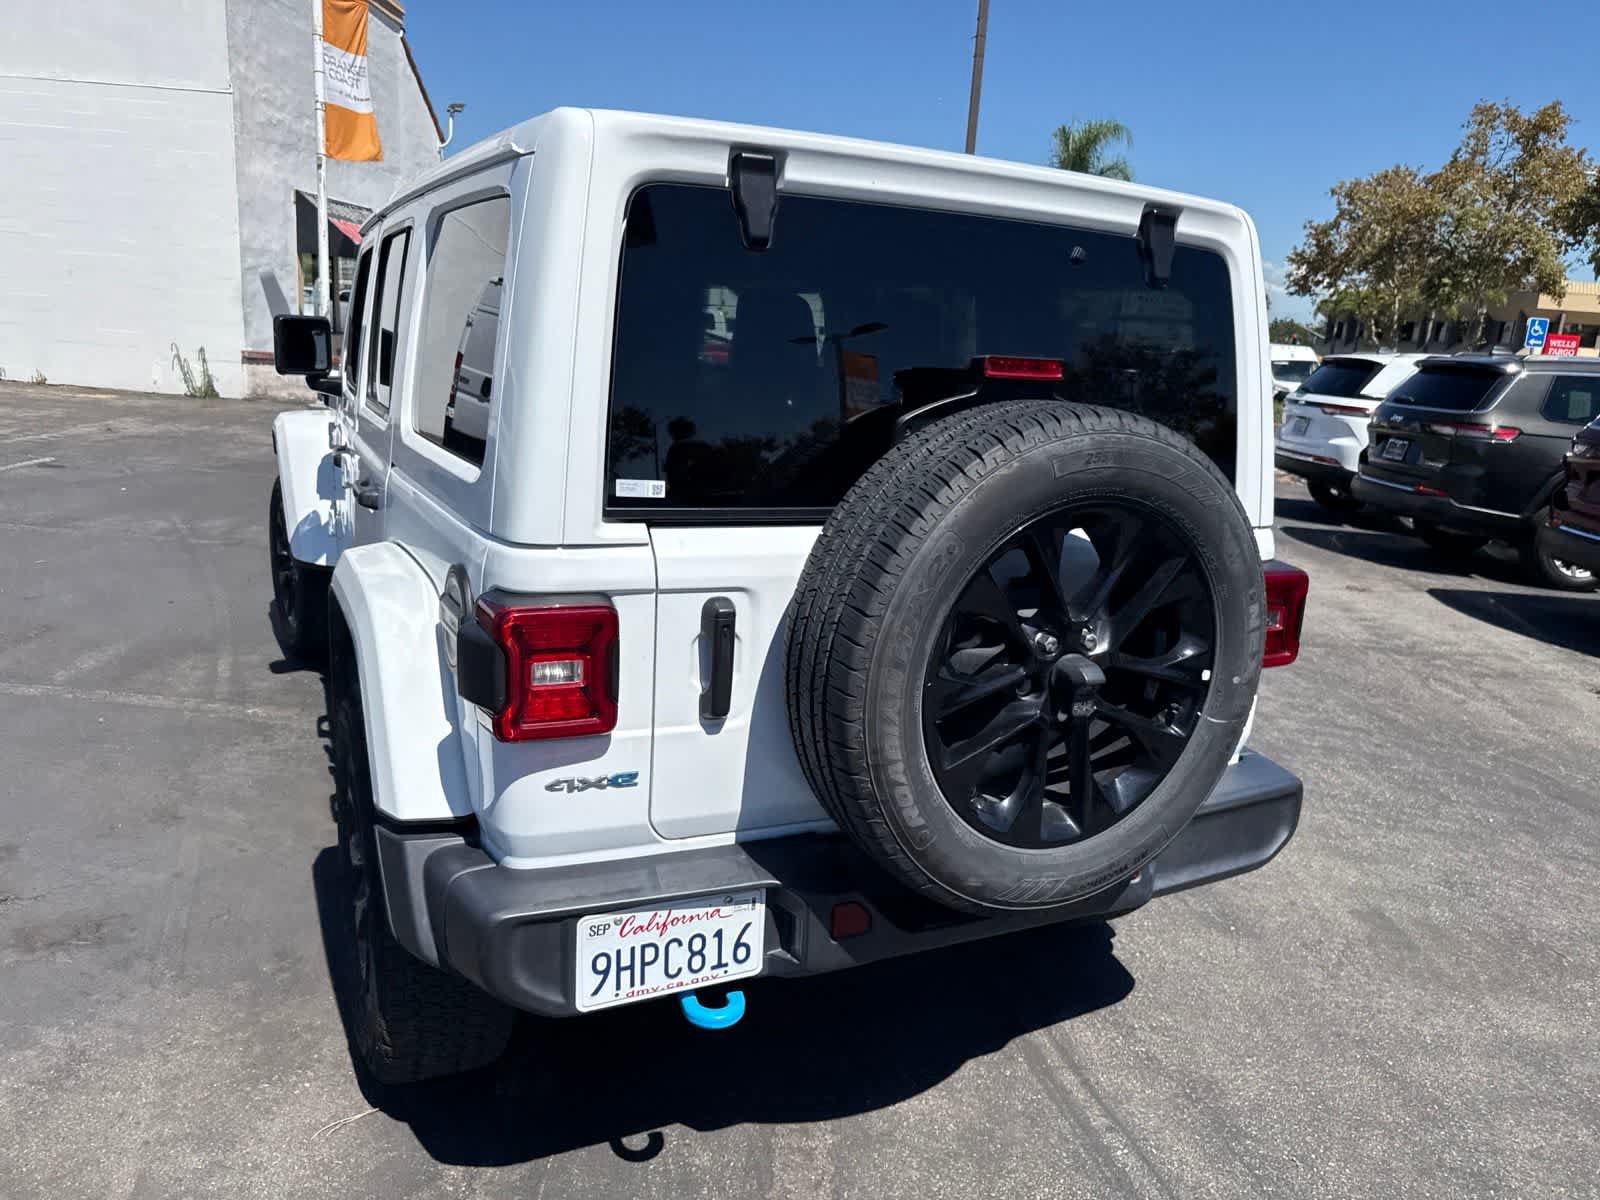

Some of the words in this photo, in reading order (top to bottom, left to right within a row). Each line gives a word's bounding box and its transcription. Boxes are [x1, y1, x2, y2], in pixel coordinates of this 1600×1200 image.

[329, 68, 360, 89] COAST
[1548, 348, 1576, 356] FARGO
[1549, 339, 1577, 348] WELLS
[588, 923, 611, 937] SEP
[619, 906, 733, 938] California
[589, 922, 753, 997] 9HPC816
[625, 972, 720, 998] dmv.ca.gov
